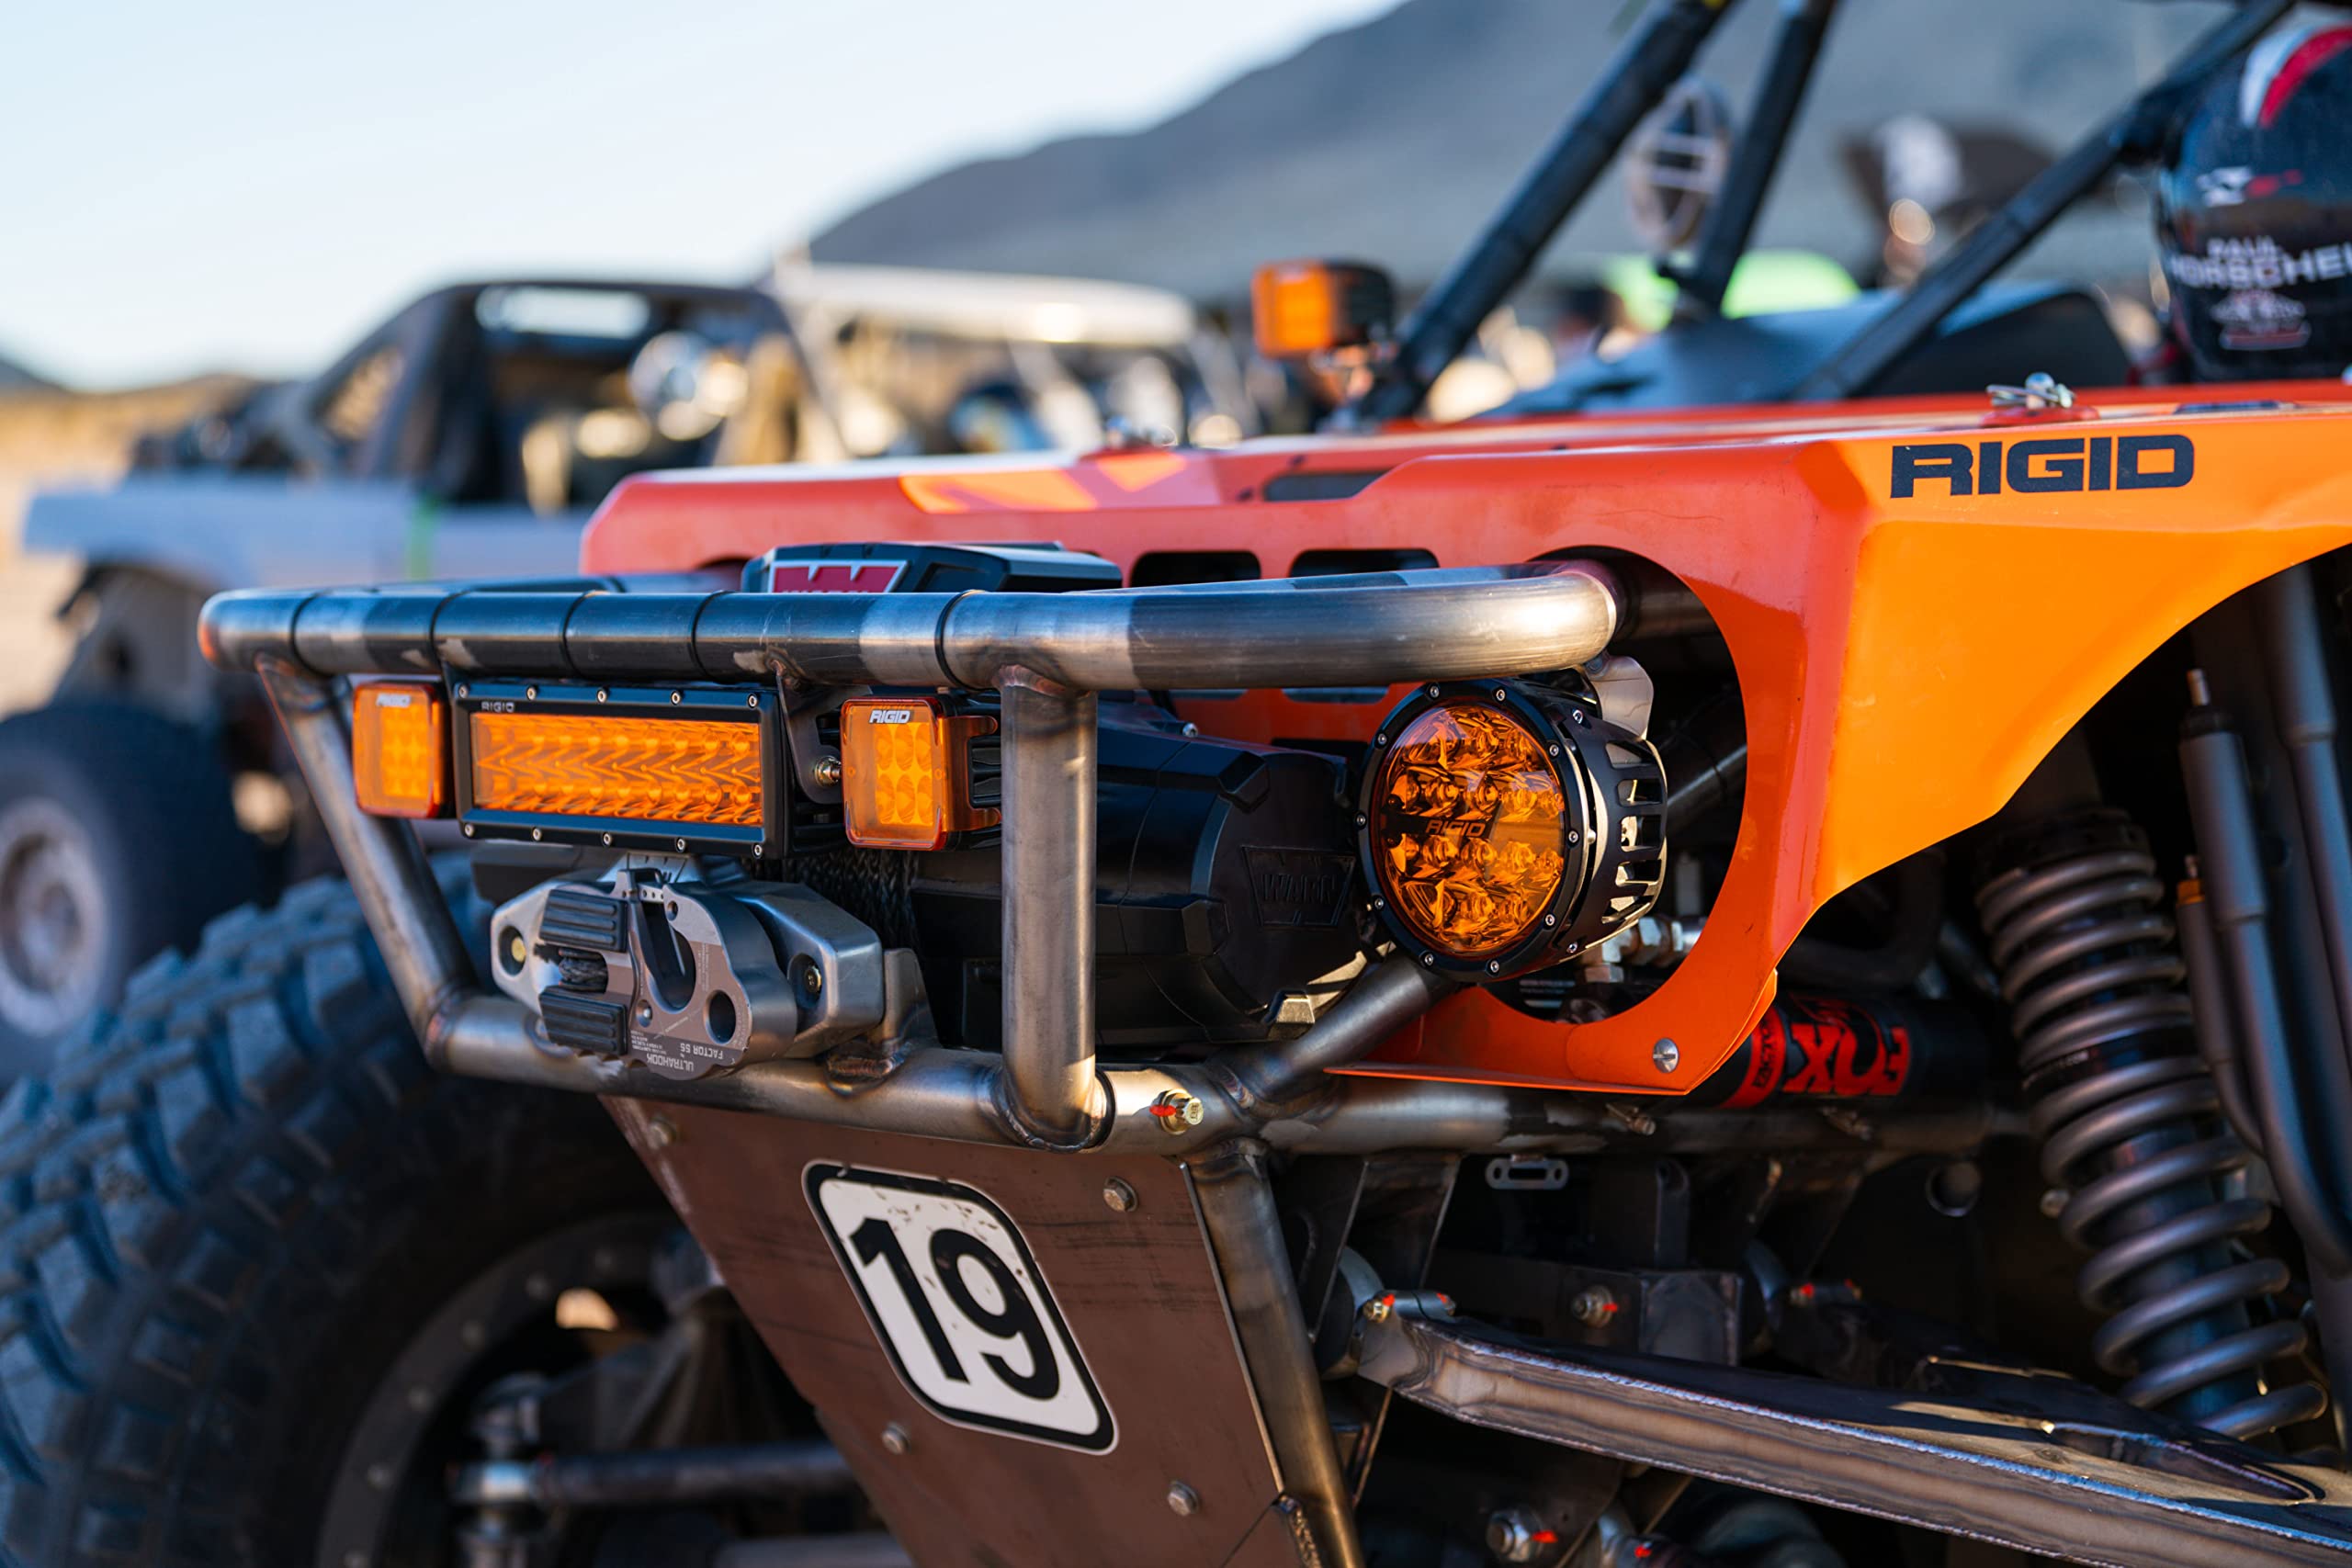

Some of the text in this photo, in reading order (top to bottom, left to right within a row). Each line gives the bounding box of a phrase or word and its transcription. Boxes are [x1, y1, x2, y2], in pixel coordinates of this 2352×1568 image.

[1890, 434, 2195, 499] RIGID
[481, 701, 514, 713] RIGID
[868, 709, 910, 724] RIGID
[1425, 819, 1486, 838] RIGID
[680, 1043, 691, 1054] 55
[693, 1044, 724, 1060] FACTOR
[1782, 1010, 1911, 1096] FOX
[646, 1053, 695, 1073] ULTRAHOOK
[849, 1217, 1060, 1402] 19
